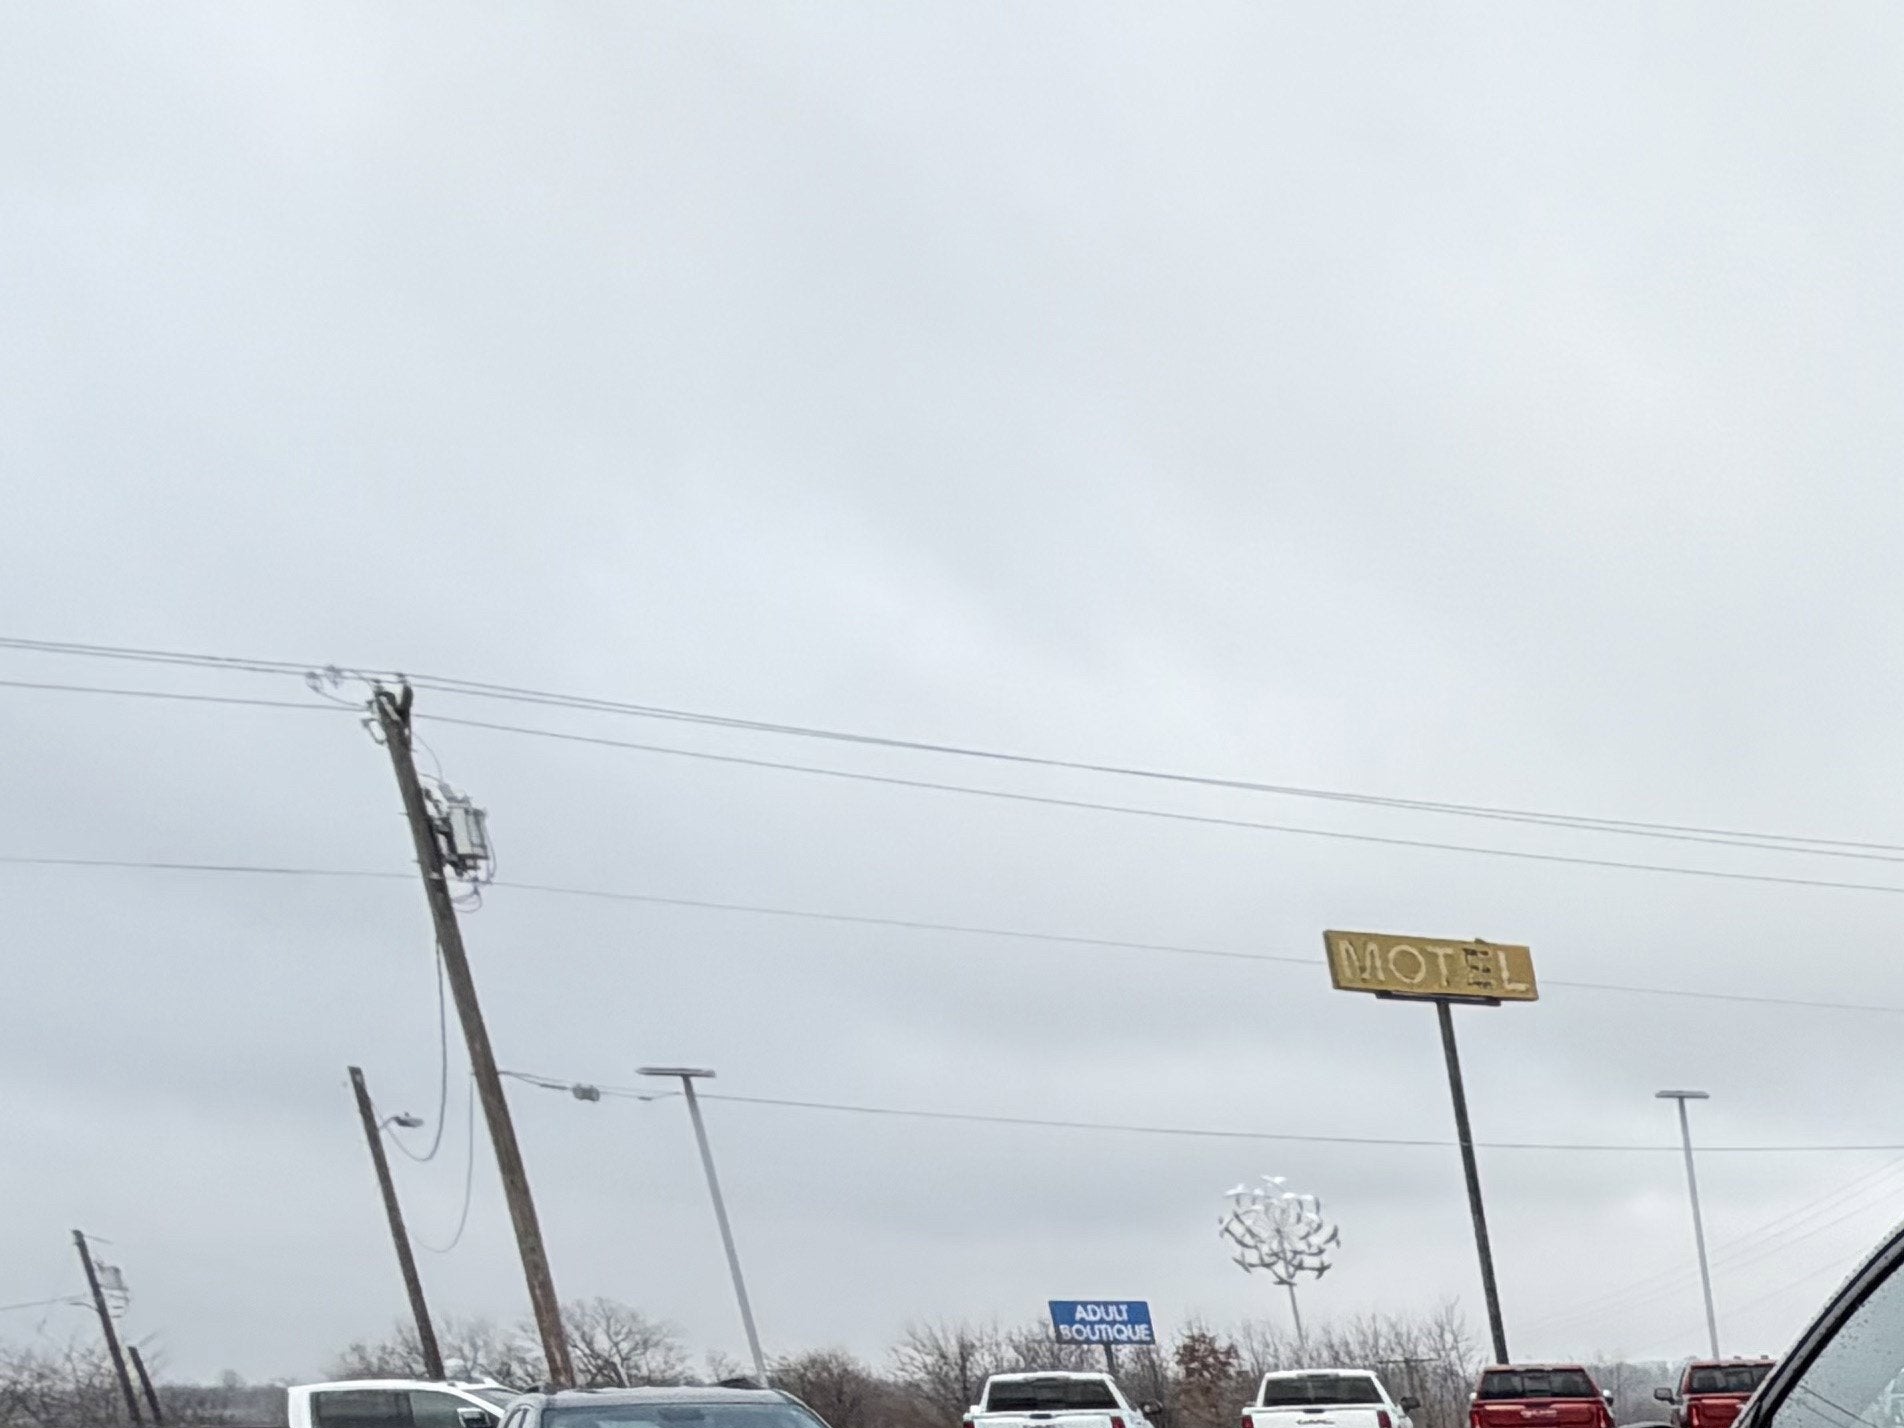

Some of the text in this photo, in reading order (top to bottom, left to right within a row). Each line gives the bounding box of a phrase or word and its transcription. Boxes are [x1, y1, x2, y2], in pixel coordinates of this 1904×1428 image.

[1338, 940, 1530, 991] MOTEL
[1075, 1304, 1128, 1321] ADULT
[1059, 1323, 1152, 1341] BOUTIQUE
